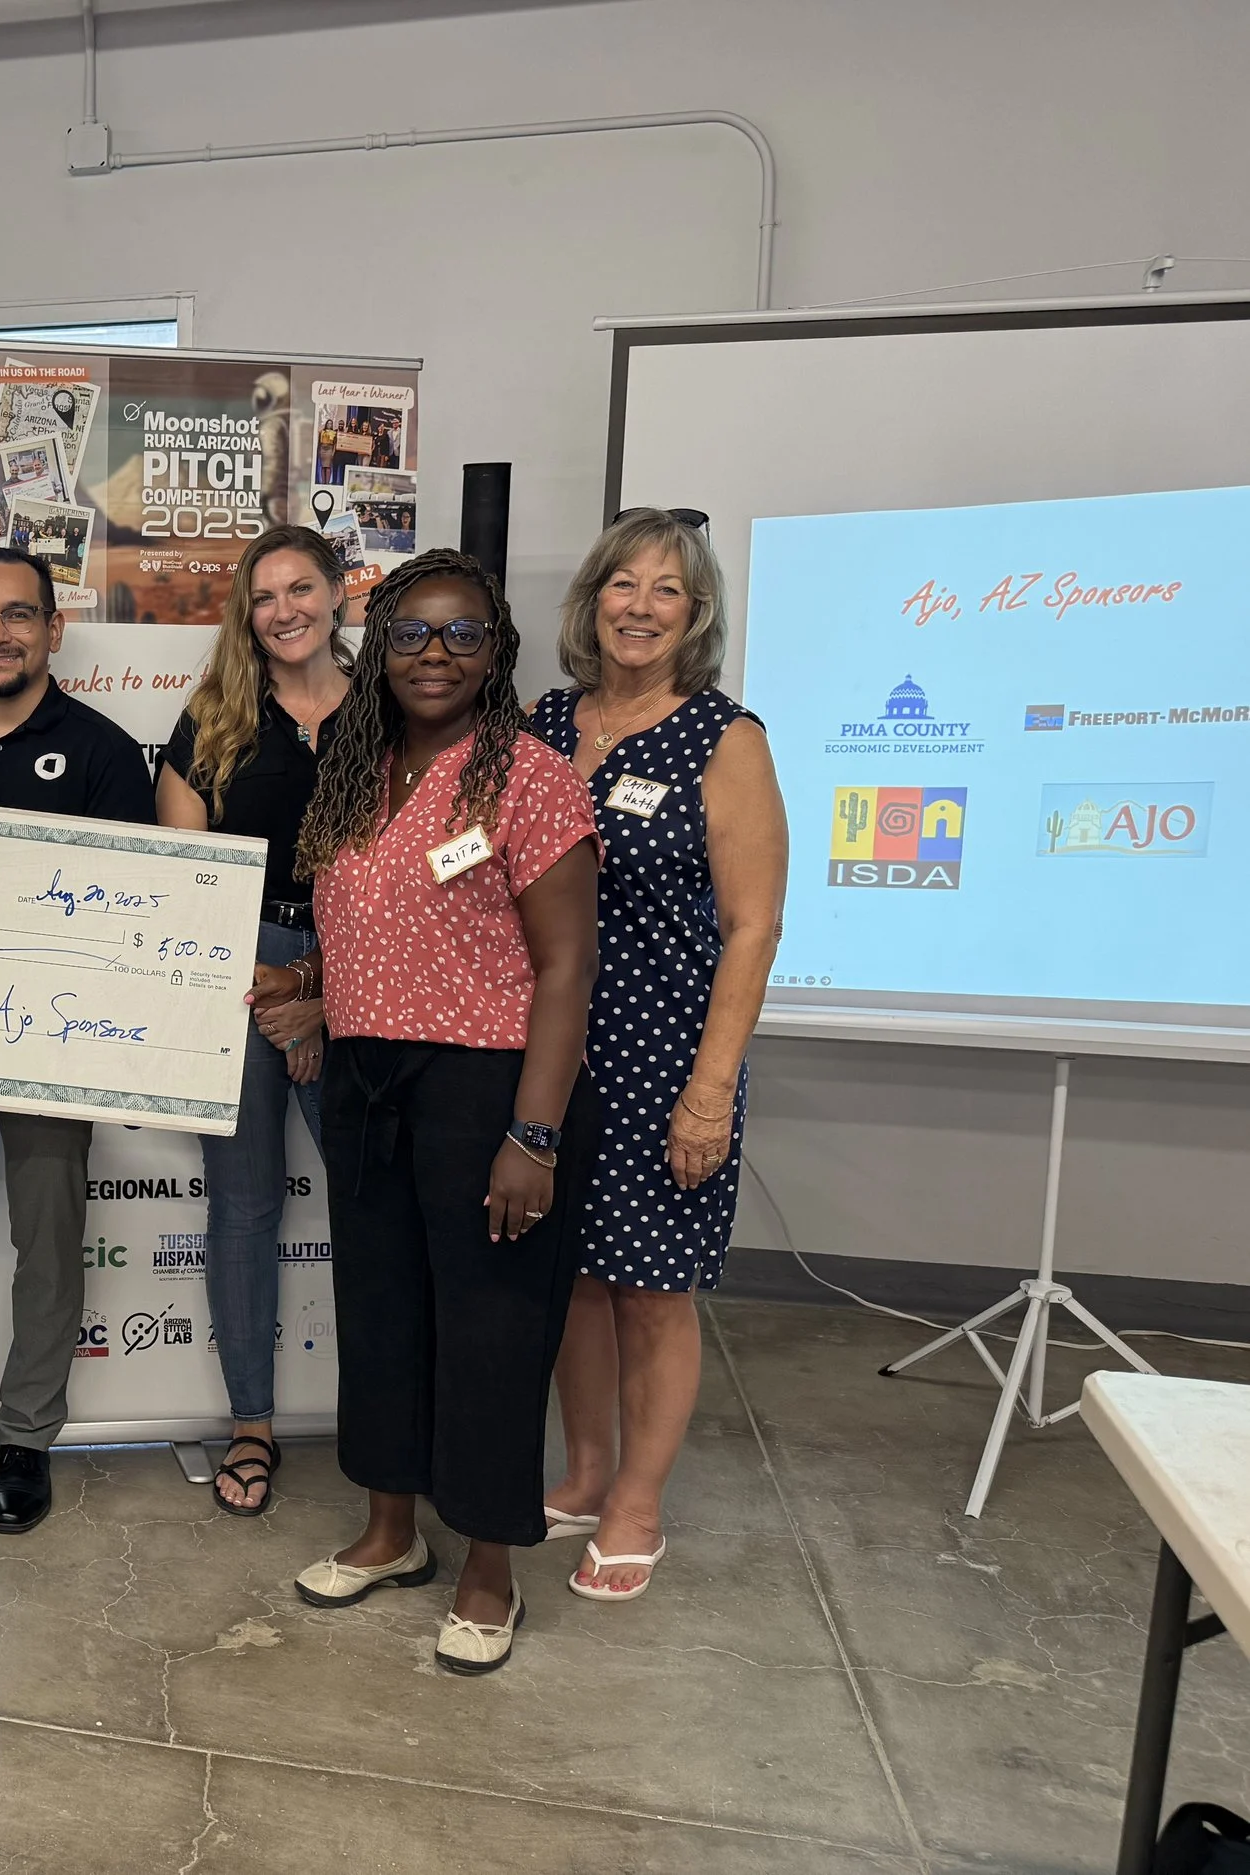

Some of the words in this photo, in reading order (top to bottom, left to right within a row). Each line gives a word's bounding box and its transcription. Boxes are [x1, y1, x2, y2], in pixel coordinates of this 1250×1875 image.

[10, 368, 23, 377] US
[25, 368, 37, 377] ON
[38, 368, 56, 377] THE
[58, 367, 85, 376] ROAD!
[318, 384, 336, 396] Last
[339, 385, 367, 399] Year's
[370, 386, 410, 400] Winner!
[24, 415, 57, 426] ARIZONA
[143, 411, 260, 435] Moonshot
[144, 433, 194, 449] RURAL
[196, 435, 262, 451] ARIZONA
[143, 451, 262, 490] PITCH
[141, 488, 261, 507] COMPETITION
[141, 505, 264, 540] 2025
[140, 549, 174, 557] Presented
[202, 563, 221, 573] aps
[360, 567, 376, 582] AZ
[68, 590, 93, 602] More!
[901, 579, 962, 627] Ajo,
[979, 572, 1043, 612] AZ
[1043, 571, 1182, 621] Sponsors
[58, 664, 113, 693] anks
[121, 666, 143, 691] to
[152, 673, 192, 690] our
[840, 723, 888, 737] PIMA
[893, 723, 971, 737] COUNTY
[824, 744, 891, 753] ECONOMIC
[893, 743, 985, 753] DEVELOPMENT
[621, 779, 659, 799] CATHY
[1104, 804, 1196, 849] AJO
[441, 841, 482, 867] RITA
[195, 873, 219, 886] 022
[836, 863, 954, 887] ISDA
[18, 895, 36, 904] DATE
[114, 891, 170, 909] 2025
[133, 932, 144, 949] $
[158, 937, 232, 961] 500.00
[114, 966, 129, 974] 100
[131, 968, 167, 977] DOLLARS
[85, 1178, 183, 1200] EGIONAL
[152, 1250, 206, 1267] HISPAN
[277, 1242, 331, 1258] LUTIO
[163, 1324, 192, 1333] STITCH
[163, 1332, 193, 1344] LAB
